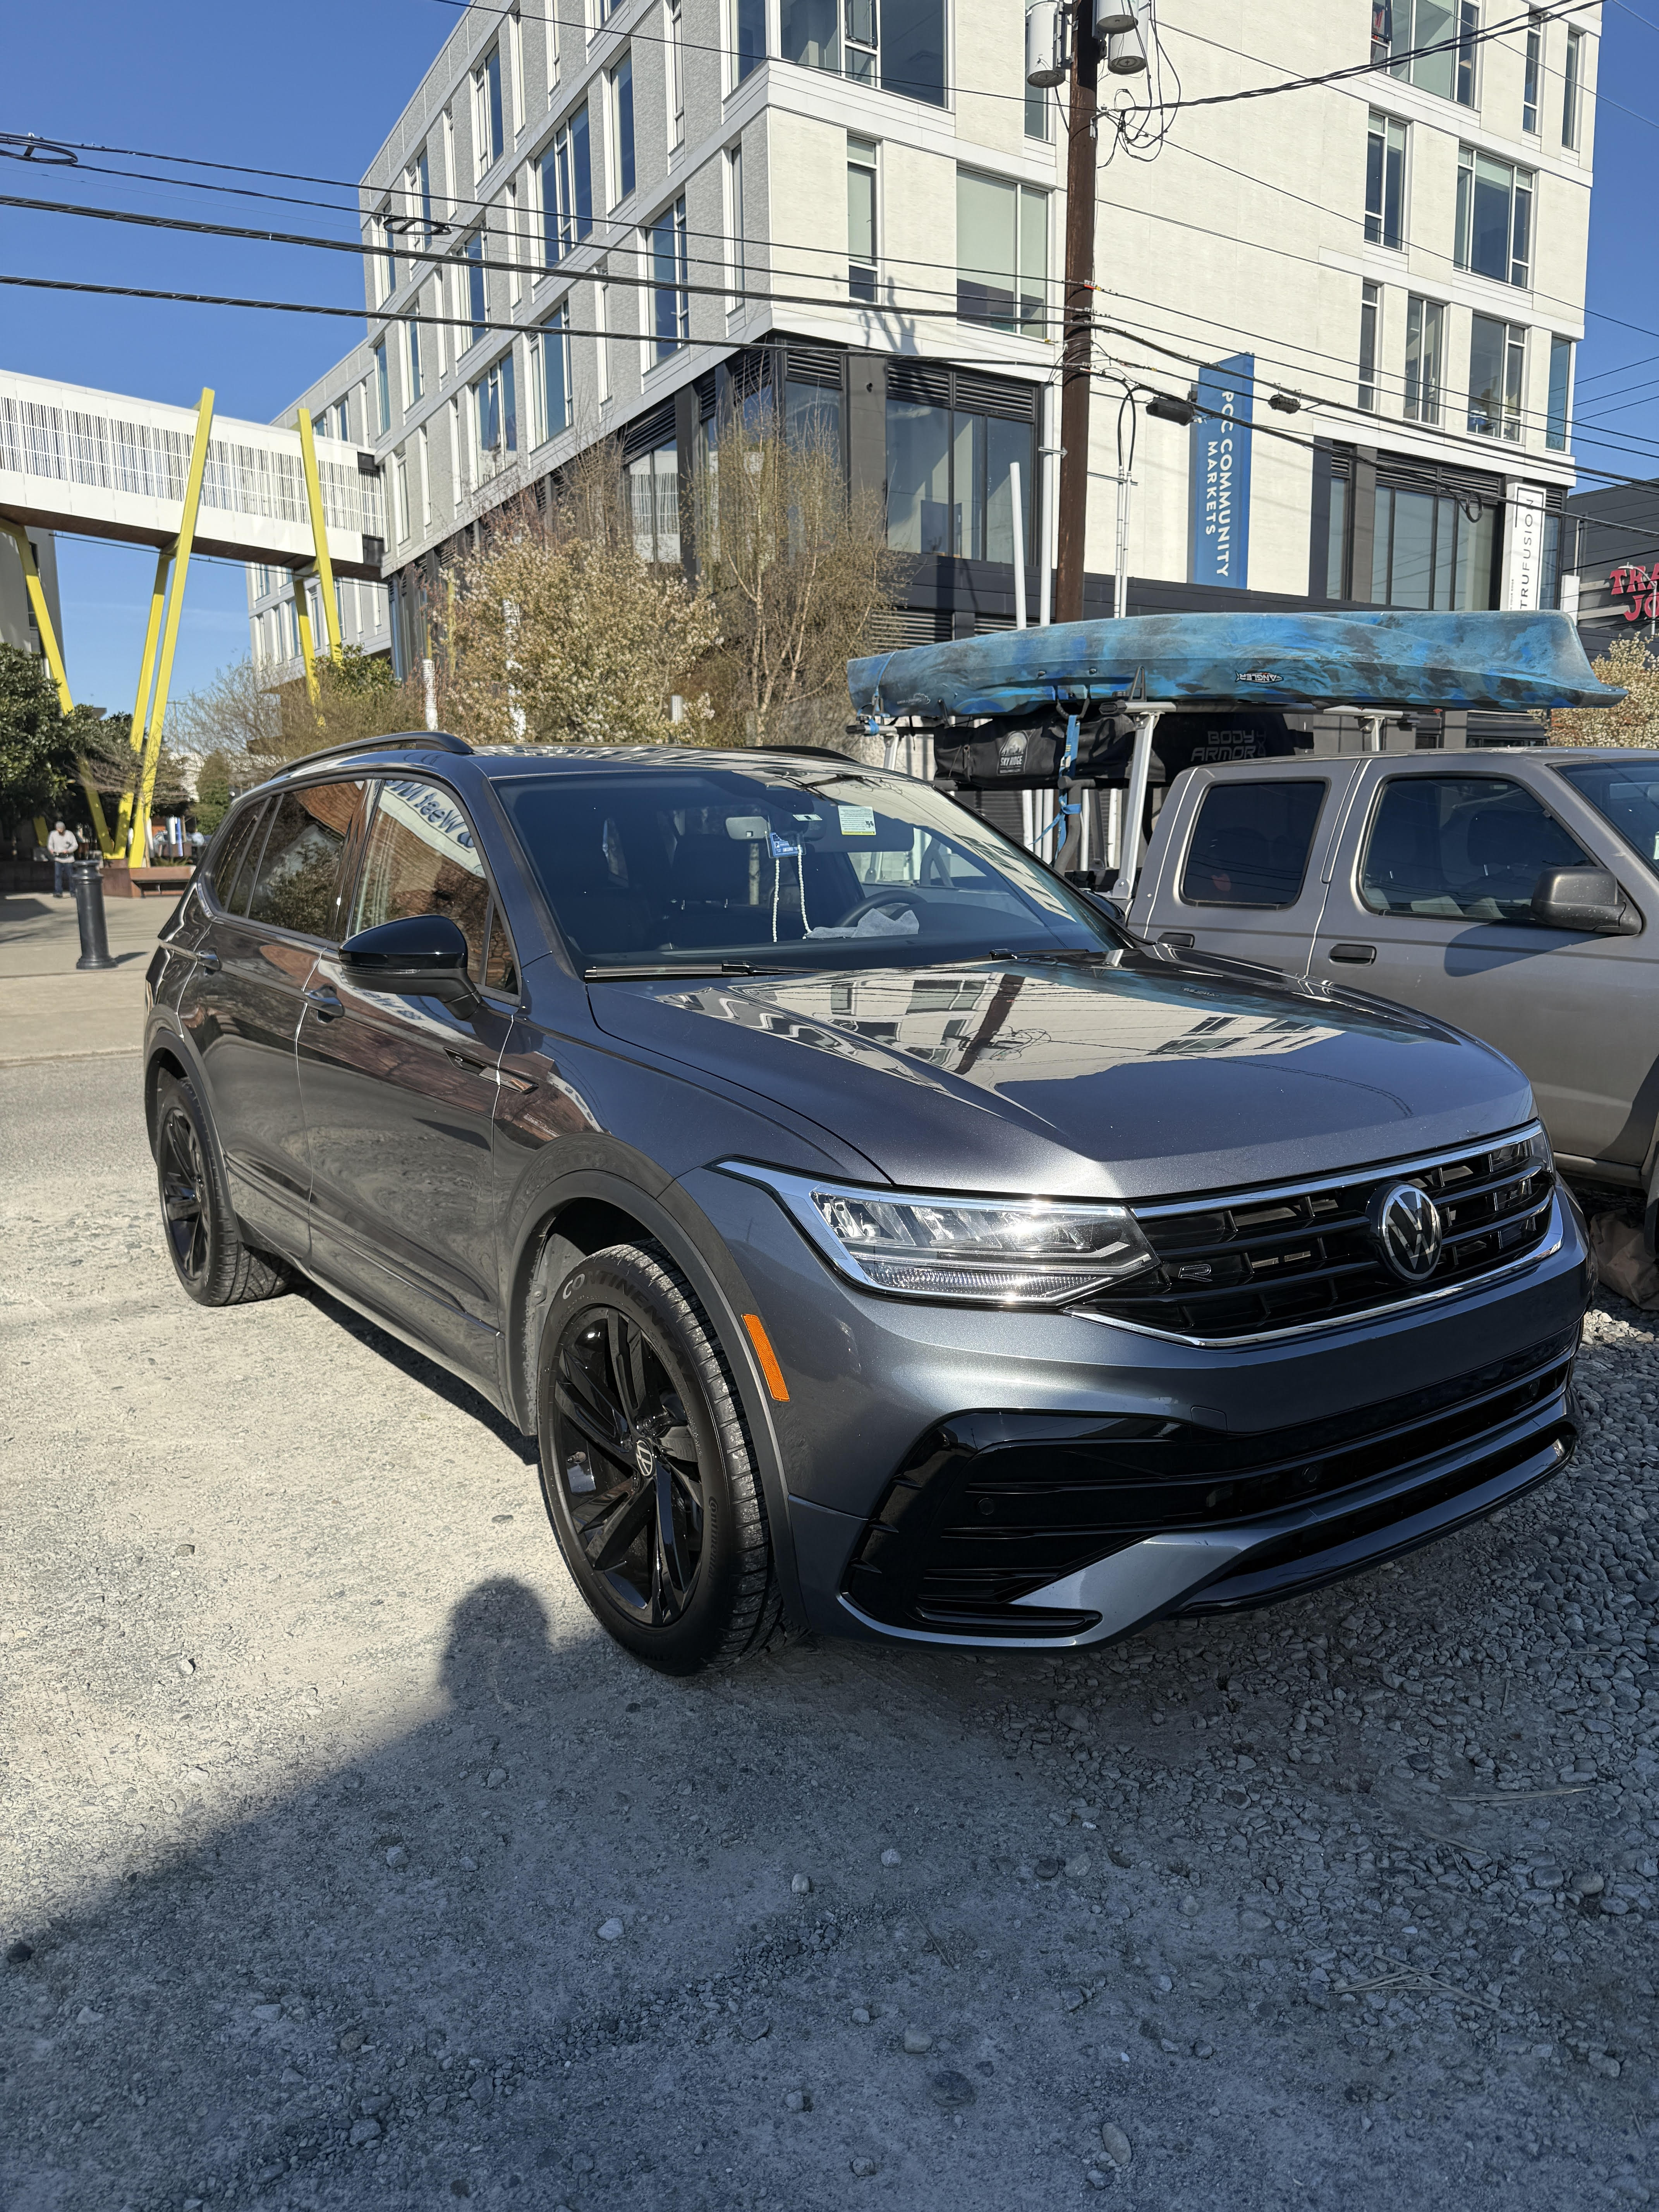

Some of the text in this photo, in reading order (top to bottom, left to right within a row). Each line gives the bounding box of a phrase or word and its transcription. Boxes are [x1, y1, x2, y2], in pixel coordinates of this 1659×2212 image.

[1206, 441, 1218, 535] MARKETS
[1217, 391, 1234, 576] PCC COMMUNITY
[1520, 499, 1534, 610] TRUFUSION
[1239, 673, 1277, 682] ANGLER
[1190, 745, 1256, 762] ARMOR
[1207, 730, 1254, 745] BODY
[1178, 1264, 1212, 1282] R
[562, 1269, 691, 1393] CONTINENTAL
